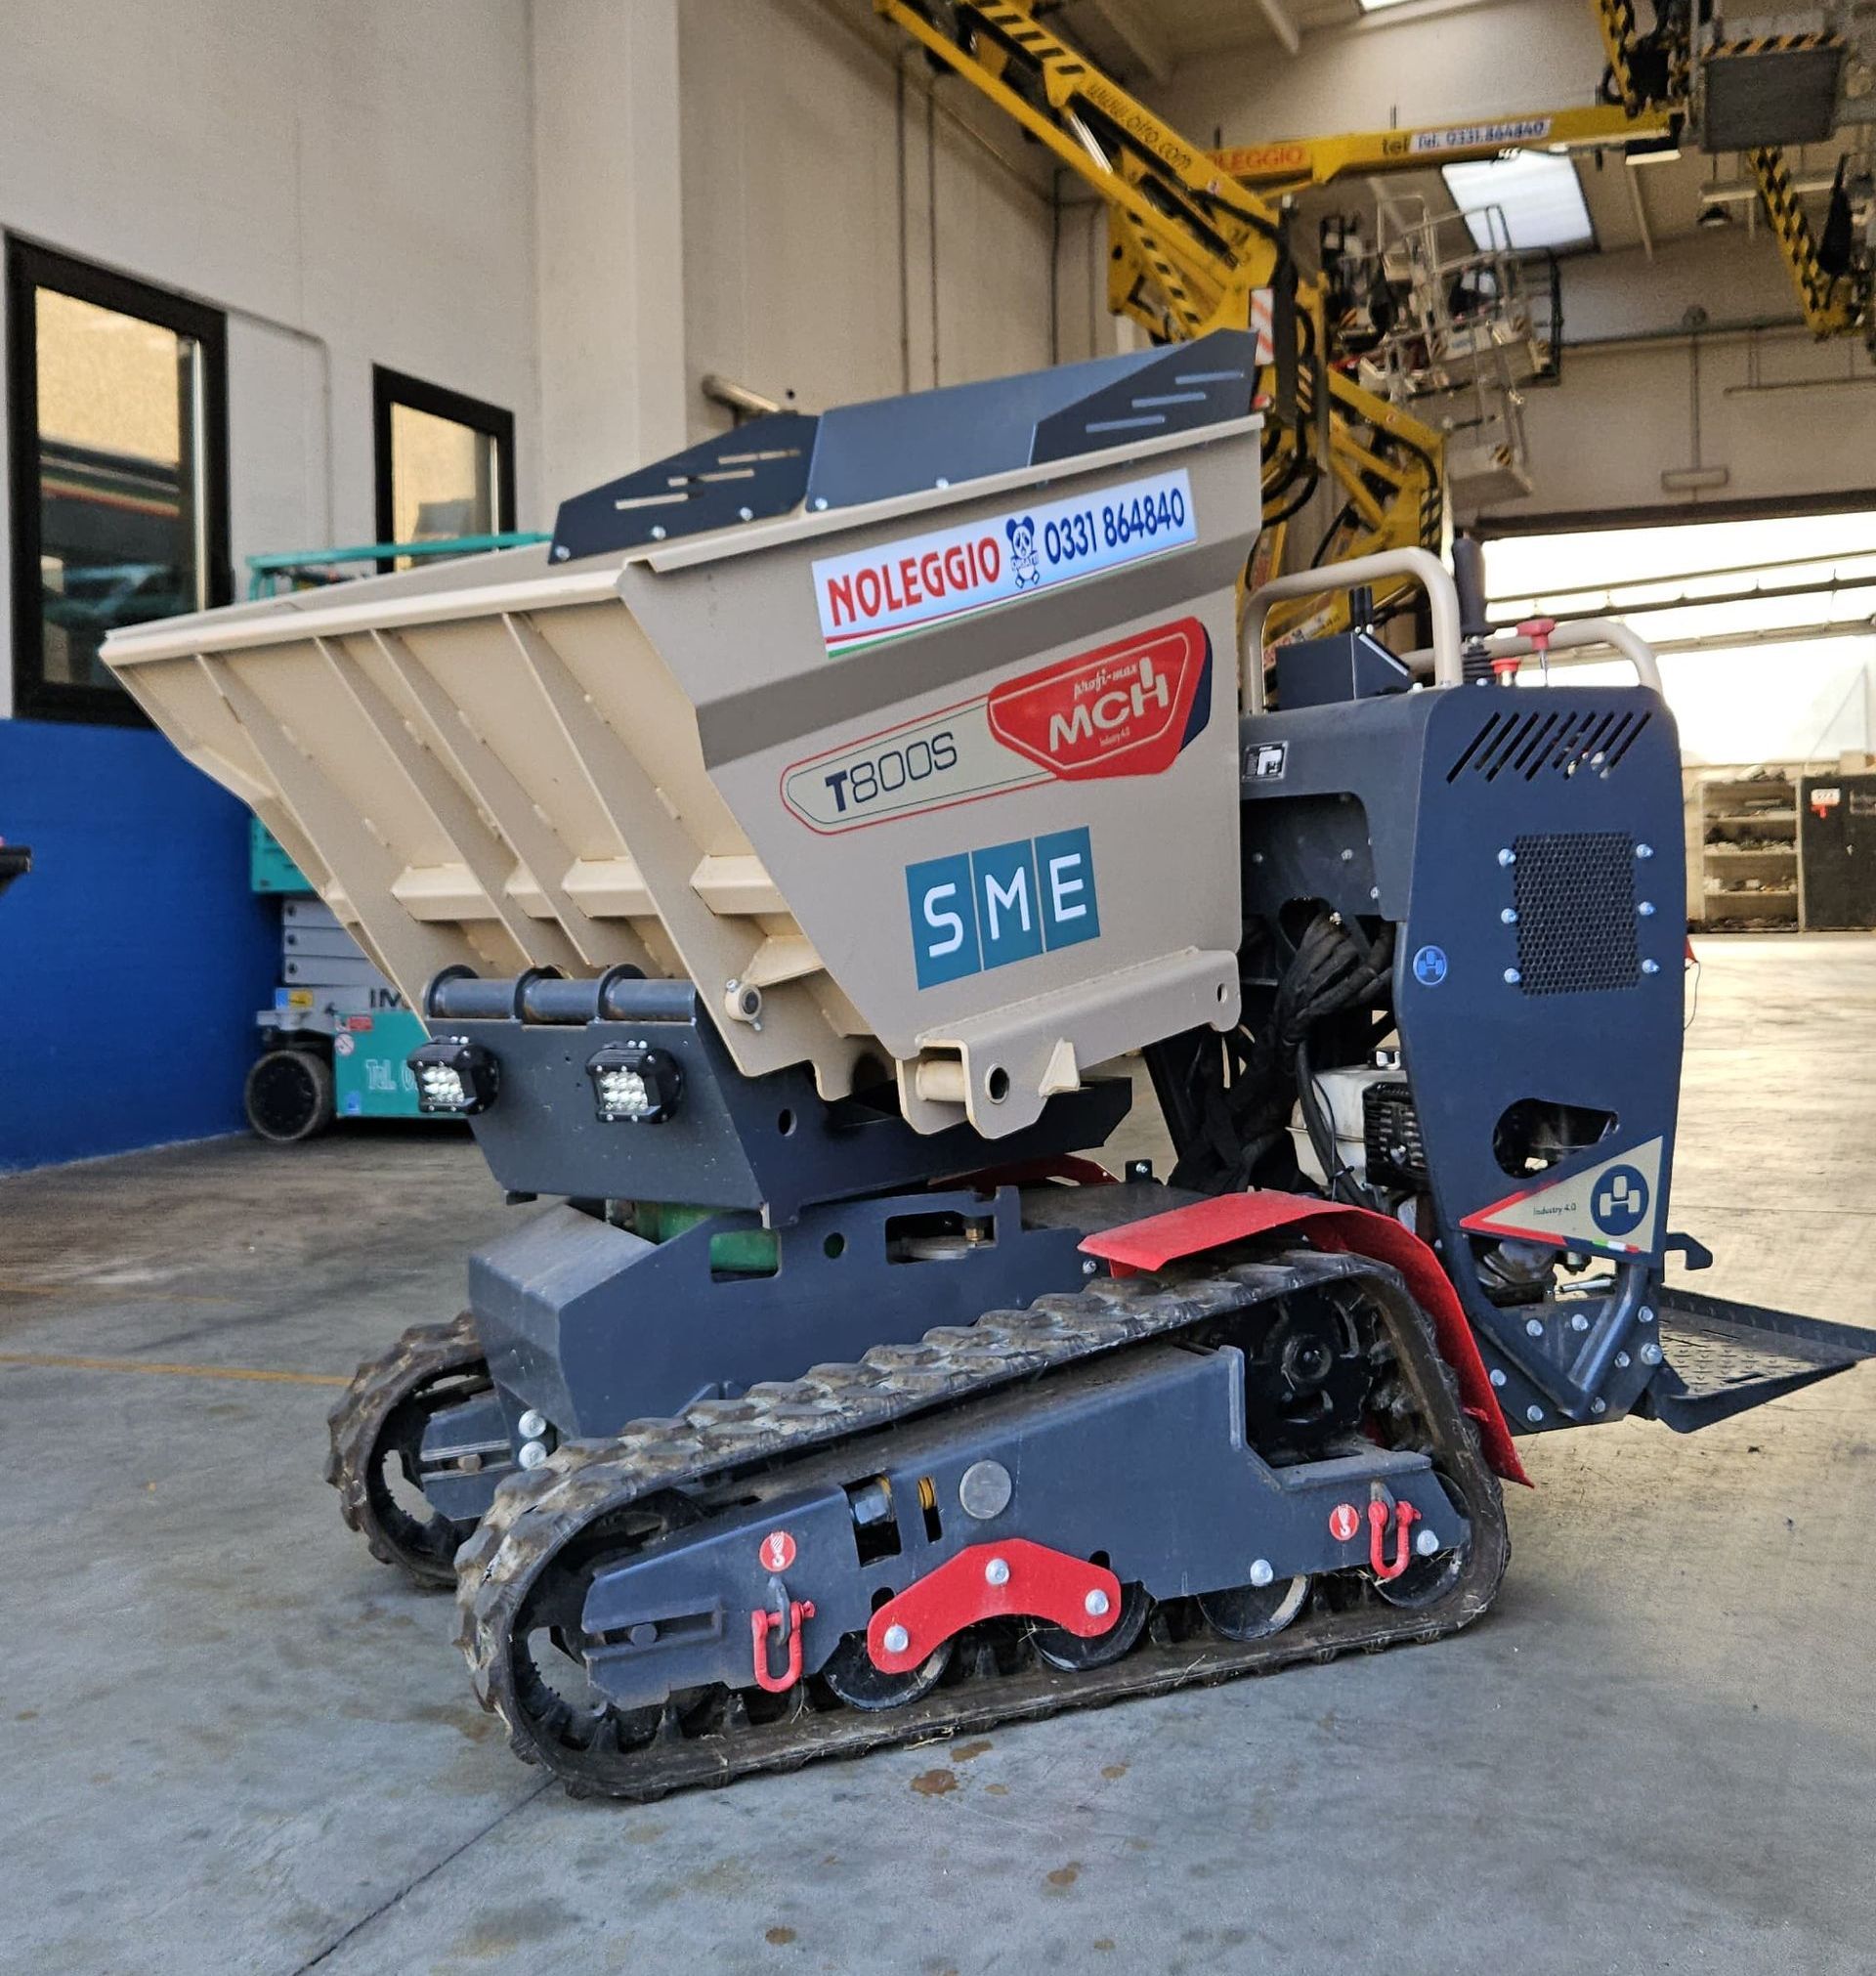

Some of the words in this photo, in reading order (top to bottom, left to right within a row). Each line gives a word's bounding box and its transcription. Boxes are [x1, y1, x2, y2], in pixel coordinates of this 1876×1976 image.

[827, 537, 1001, 626] NOLEGGIO
[1044, 510, 1097, 564] 0331
[1103, 487, 1184, 547] 864840
[1049, 656, 1169, 752] MCH
[825, 731, 958, 812] T800S
[922, 852, 1087, 958] SME
